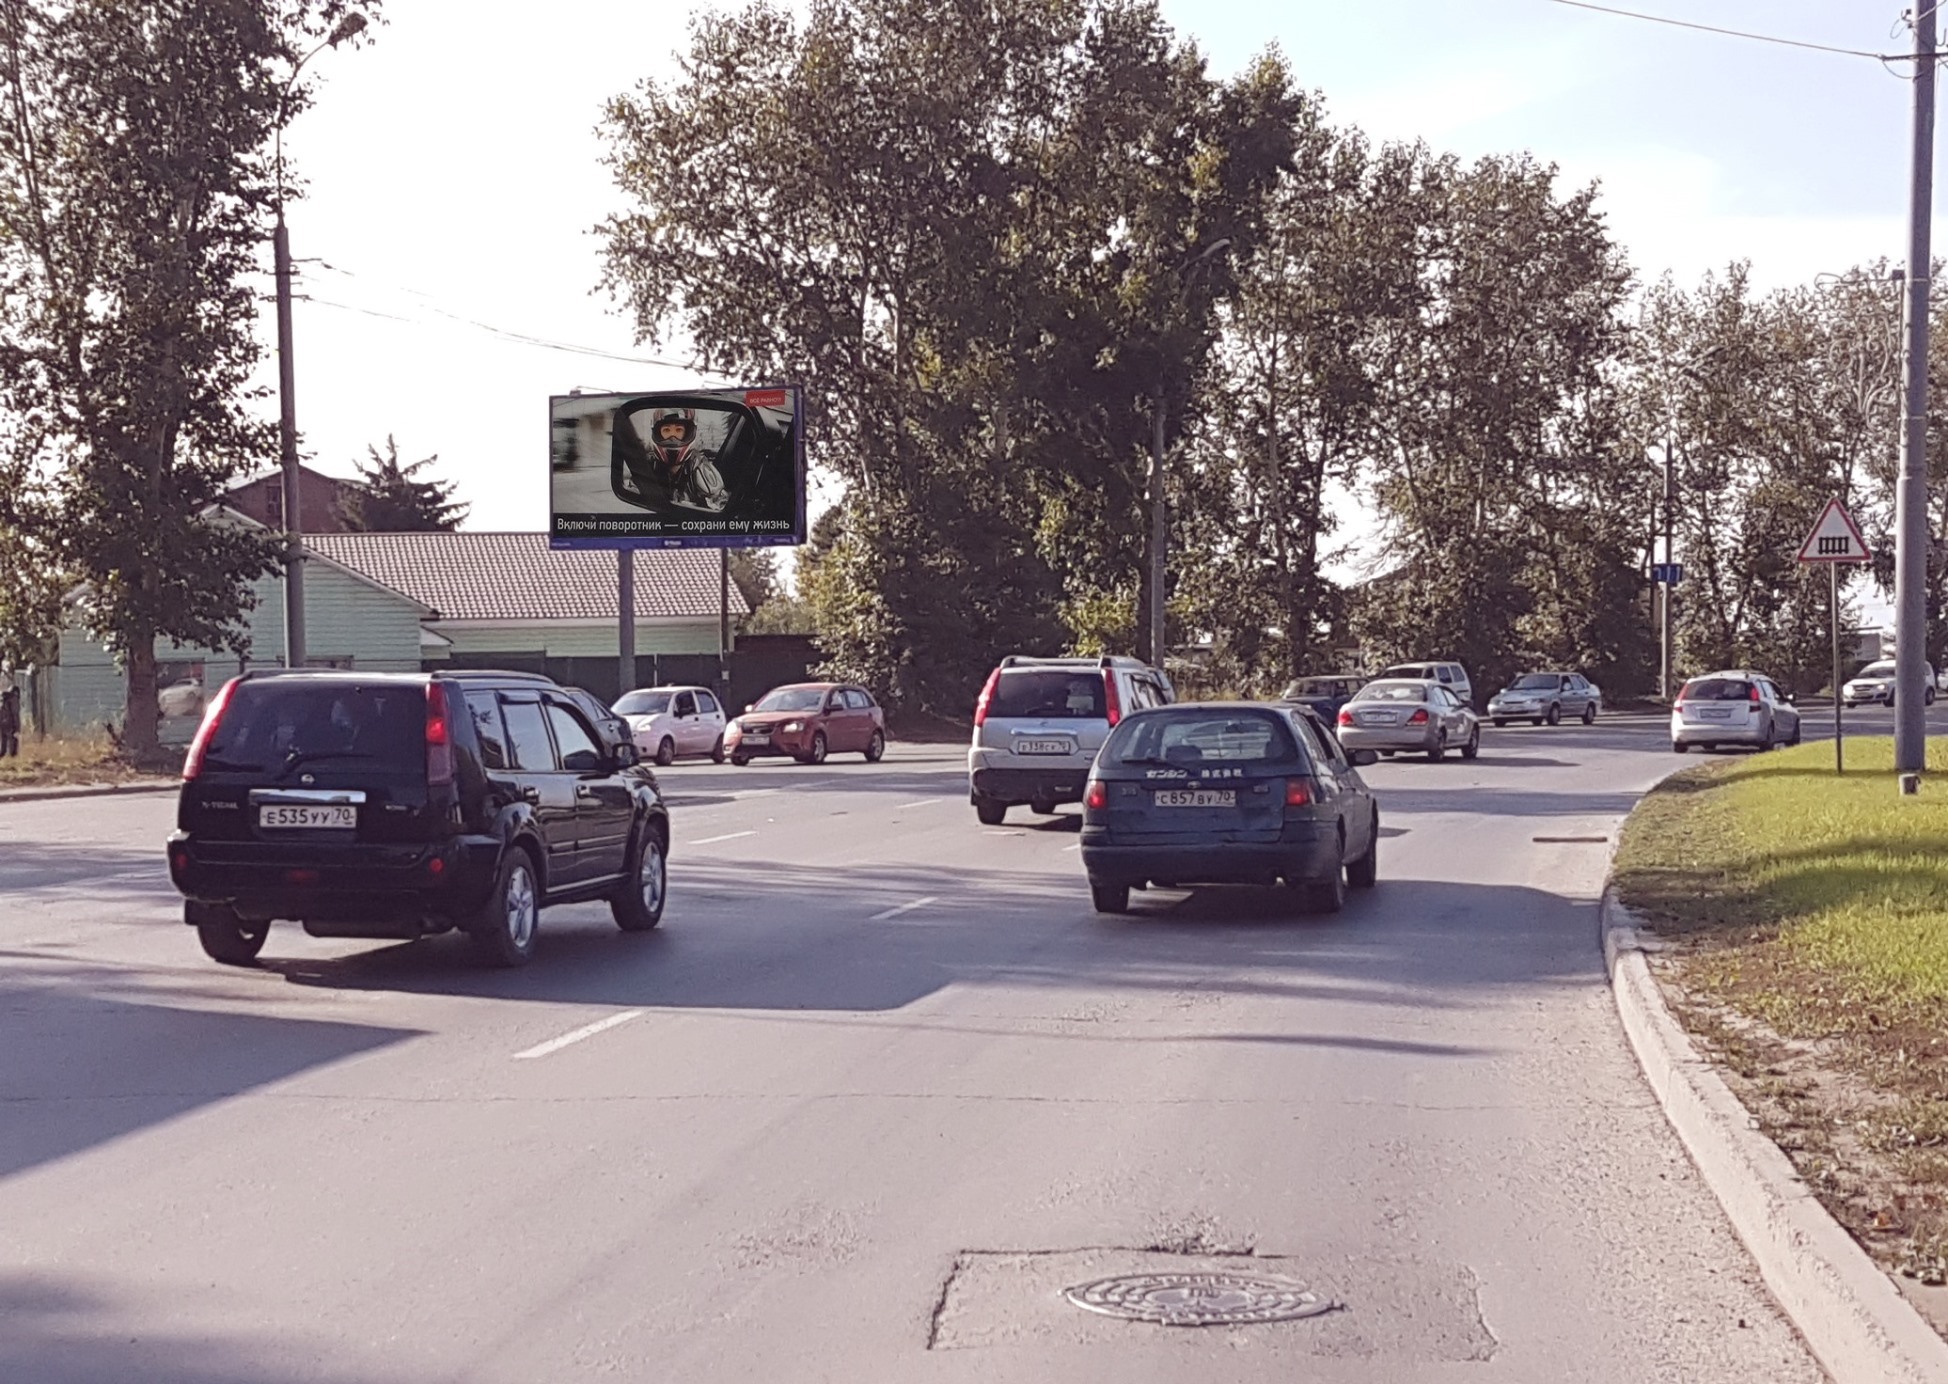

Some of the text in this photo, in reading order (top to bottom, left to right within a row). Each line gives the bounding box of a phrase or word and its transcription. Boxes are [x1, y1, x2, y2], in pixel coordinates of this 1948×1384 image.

[557, 518, 597, 531] Включи
[599, 521, 662, 533] поворотник
[681, 521, 726, 533] сохрани
[728, 520, 750, 533] ему
[753, 520, 790, 530] жизнь
